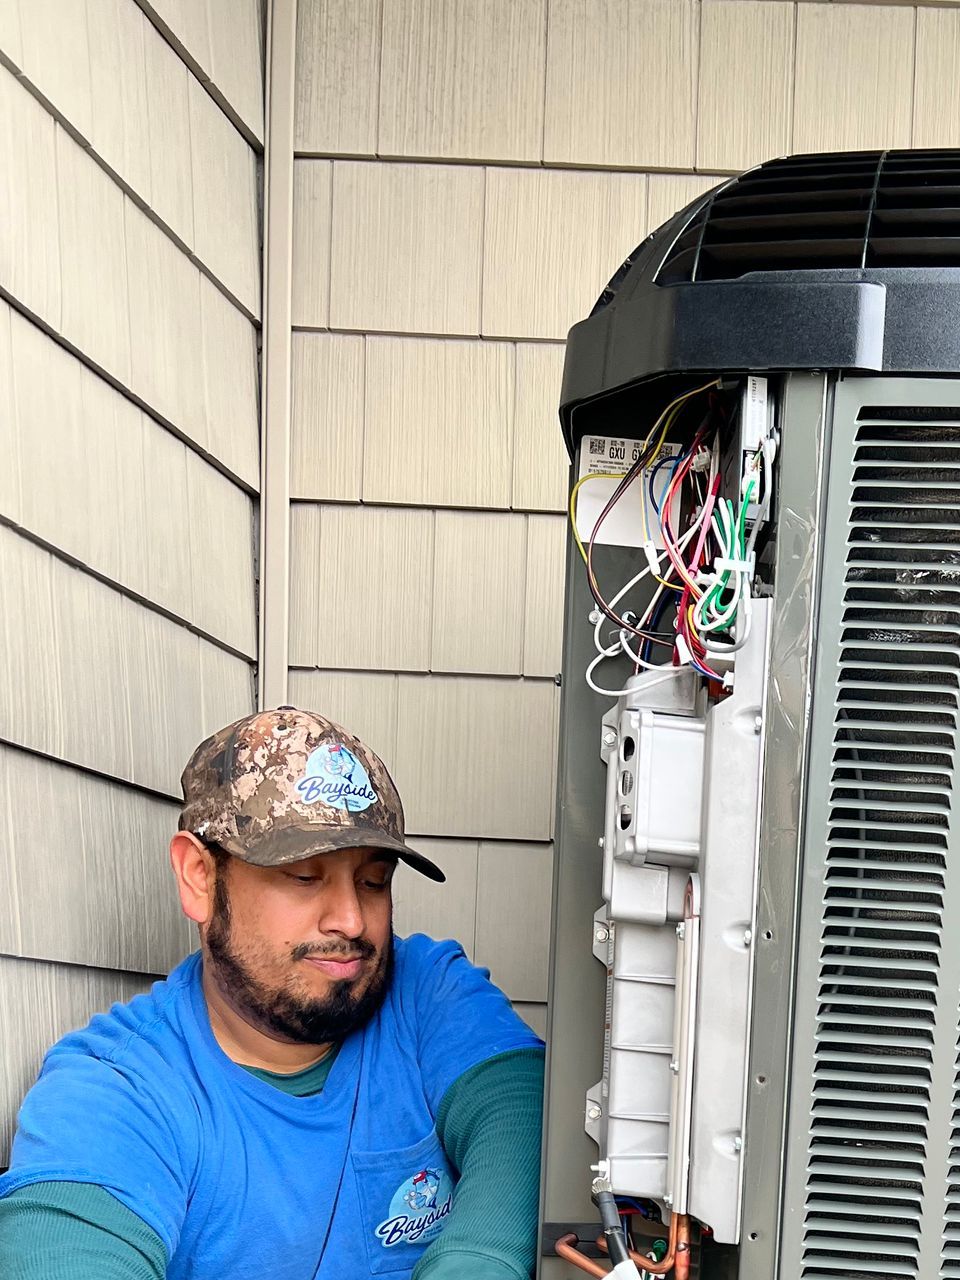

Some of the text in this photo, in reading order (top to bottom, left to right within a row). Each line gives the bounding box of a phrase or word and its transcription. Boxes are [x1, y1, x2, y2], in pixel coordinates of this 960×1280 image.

[609, 446, 626, 460] GXU
[298, 775, 376, 802] Bayside
[379, 1193, 452, 1245] Baysid
